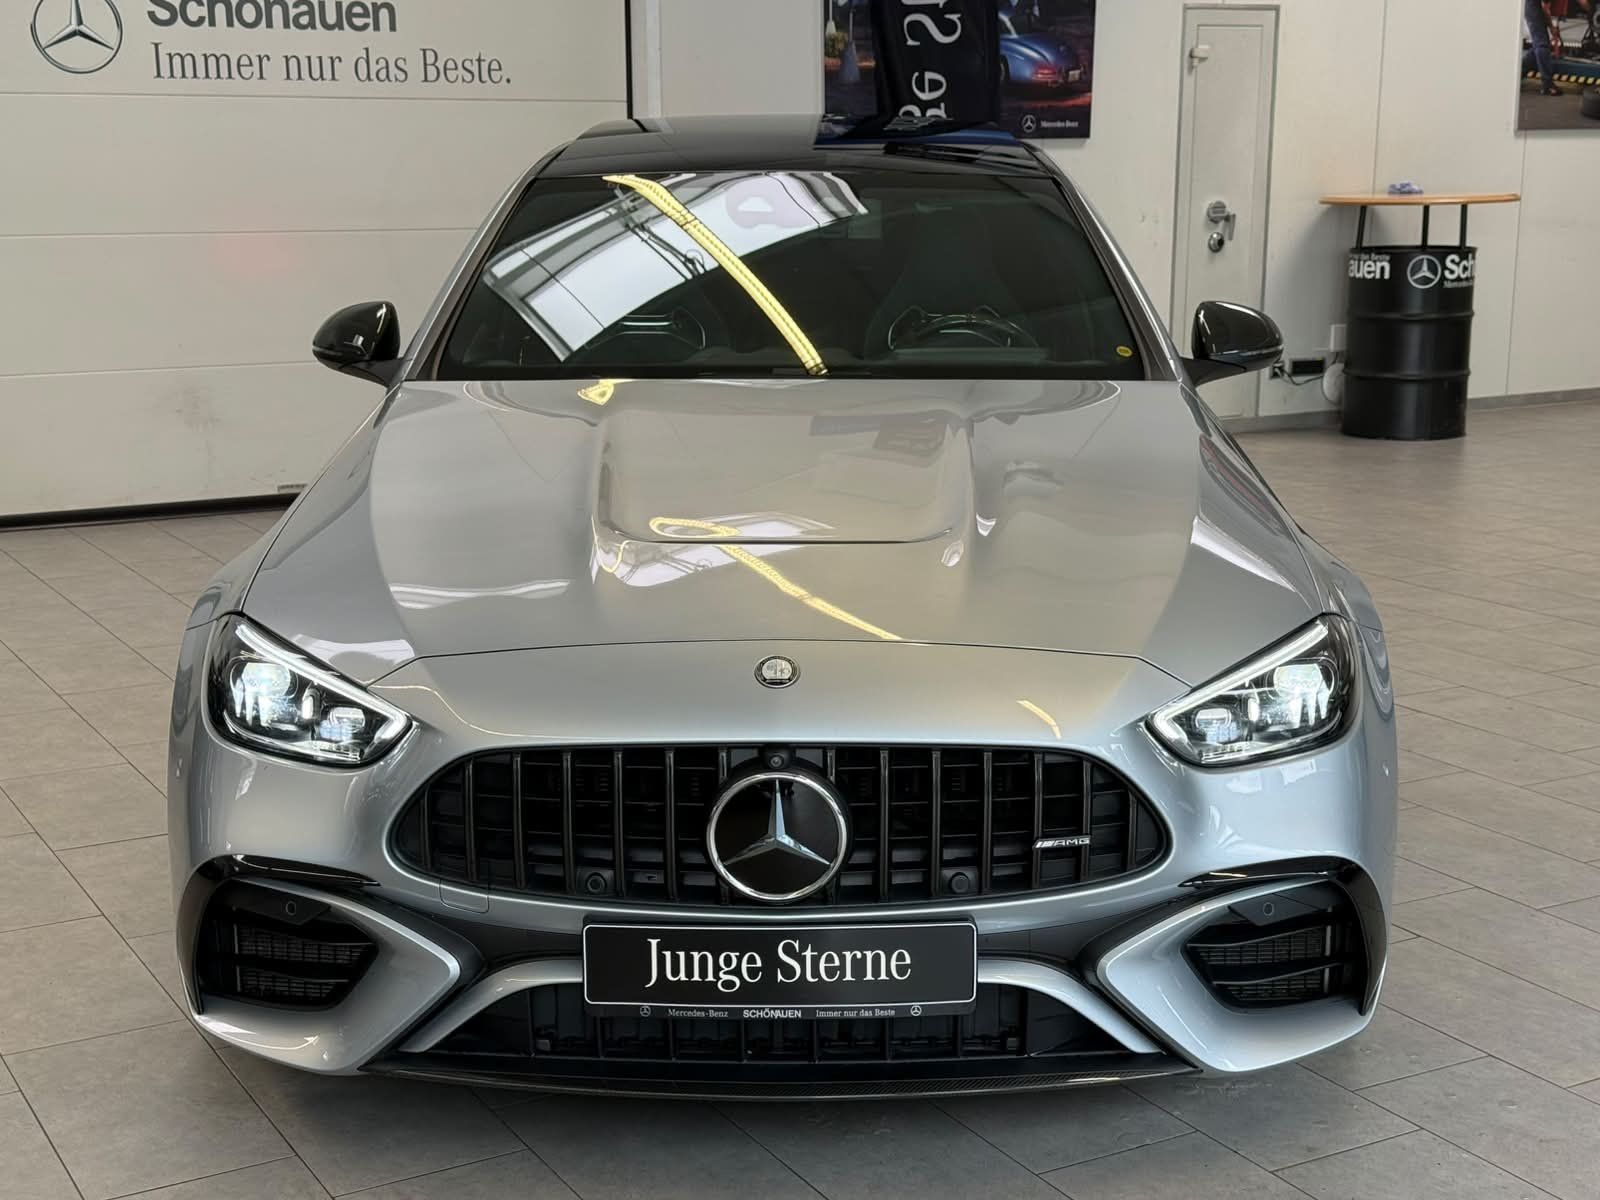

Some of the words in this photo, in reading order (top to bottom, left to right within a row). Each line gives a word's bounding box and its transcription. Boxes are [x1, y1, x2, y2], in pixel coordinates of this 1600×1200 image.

[150, 42, 271, 81] Immer
[283, 53, 342, 82] nur
[354, 47, 409, 84] das
[419, 48, 511, 84] Beste.
[644, 937, 762, 993] Junge
[777, 938, 912, 983] Sterne
[668, 1008, 729, 1018] Mercedes-Benz
[816, 1009, 841, 1017] Immer
[844, 1009, 860, 1017] nur
[861, 1008, 873, 1017] das
[875, 1008, 896, 1017] Beste
